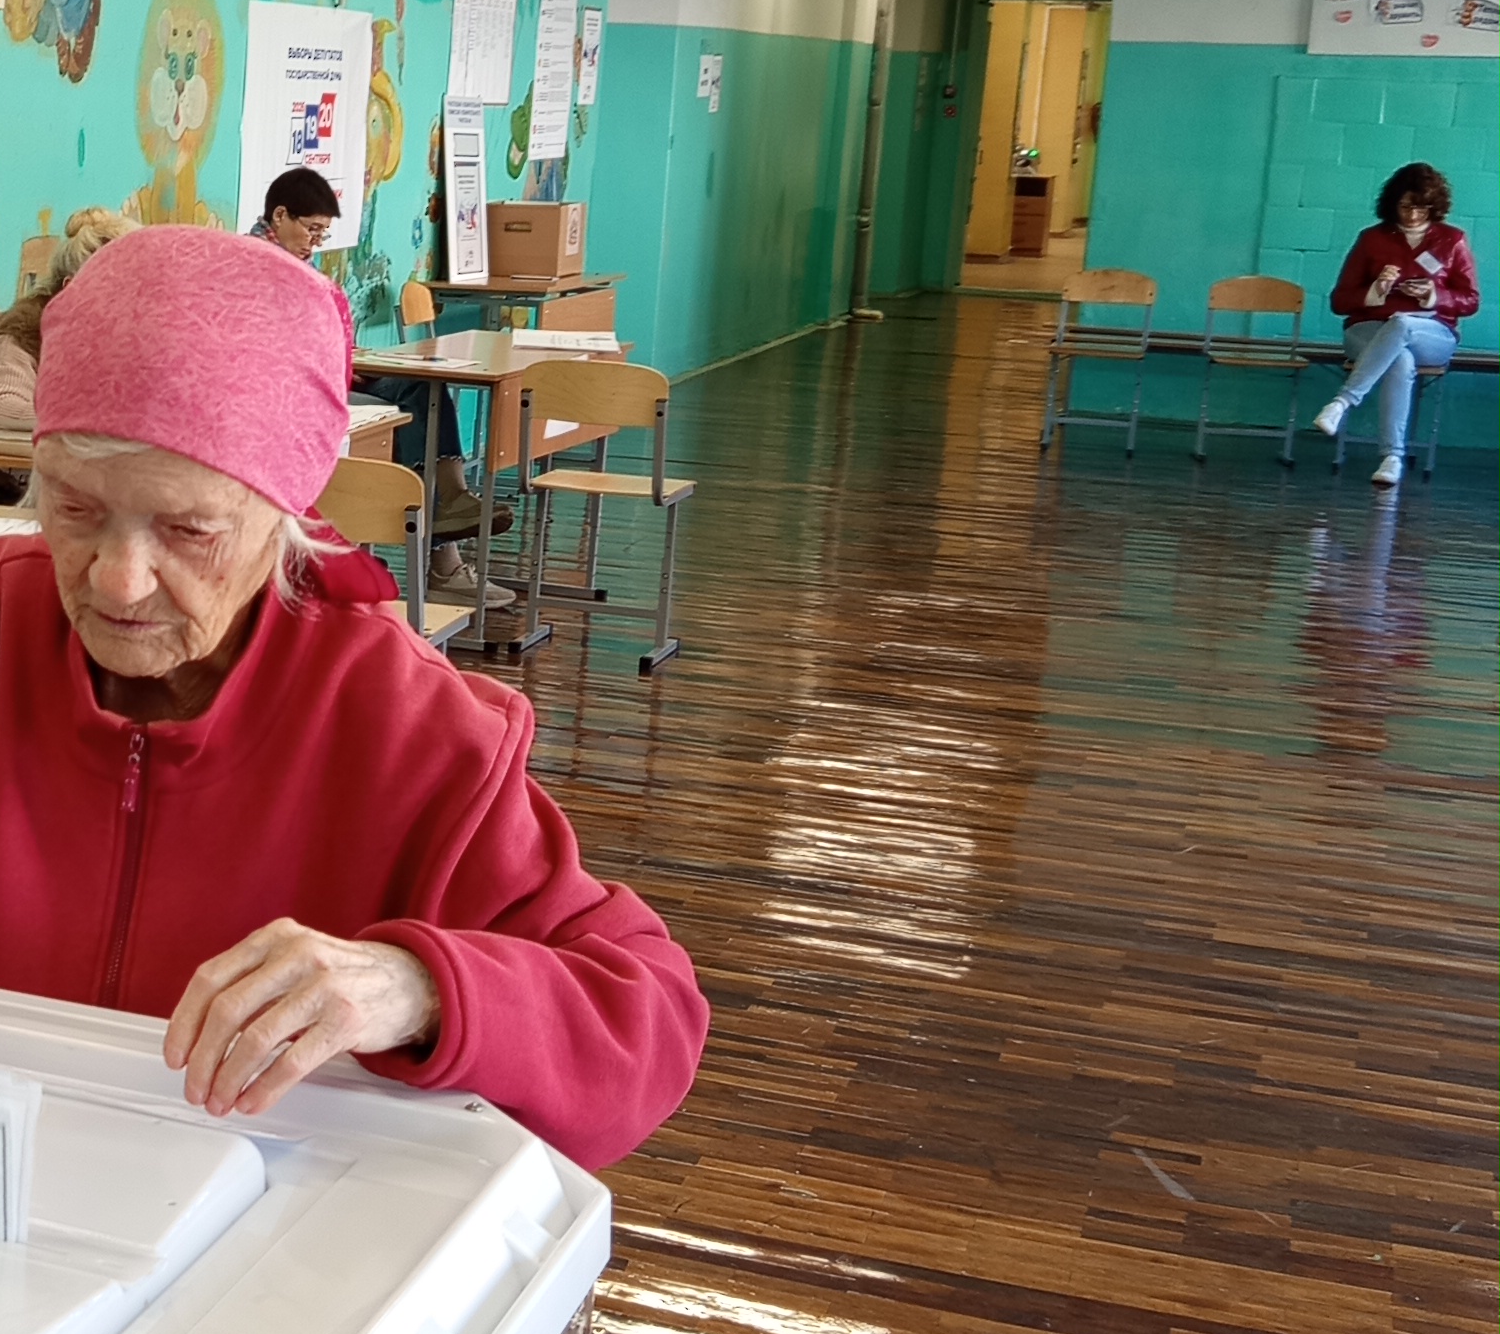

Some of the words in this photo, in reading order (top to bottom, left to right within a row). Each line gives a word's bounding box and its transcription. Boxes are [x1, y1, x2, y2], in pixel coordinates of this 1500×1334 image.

[305, 115, 317, 140] 19
[319, 103, 333, 128] 20
[291, 129, 303, 154] 18
